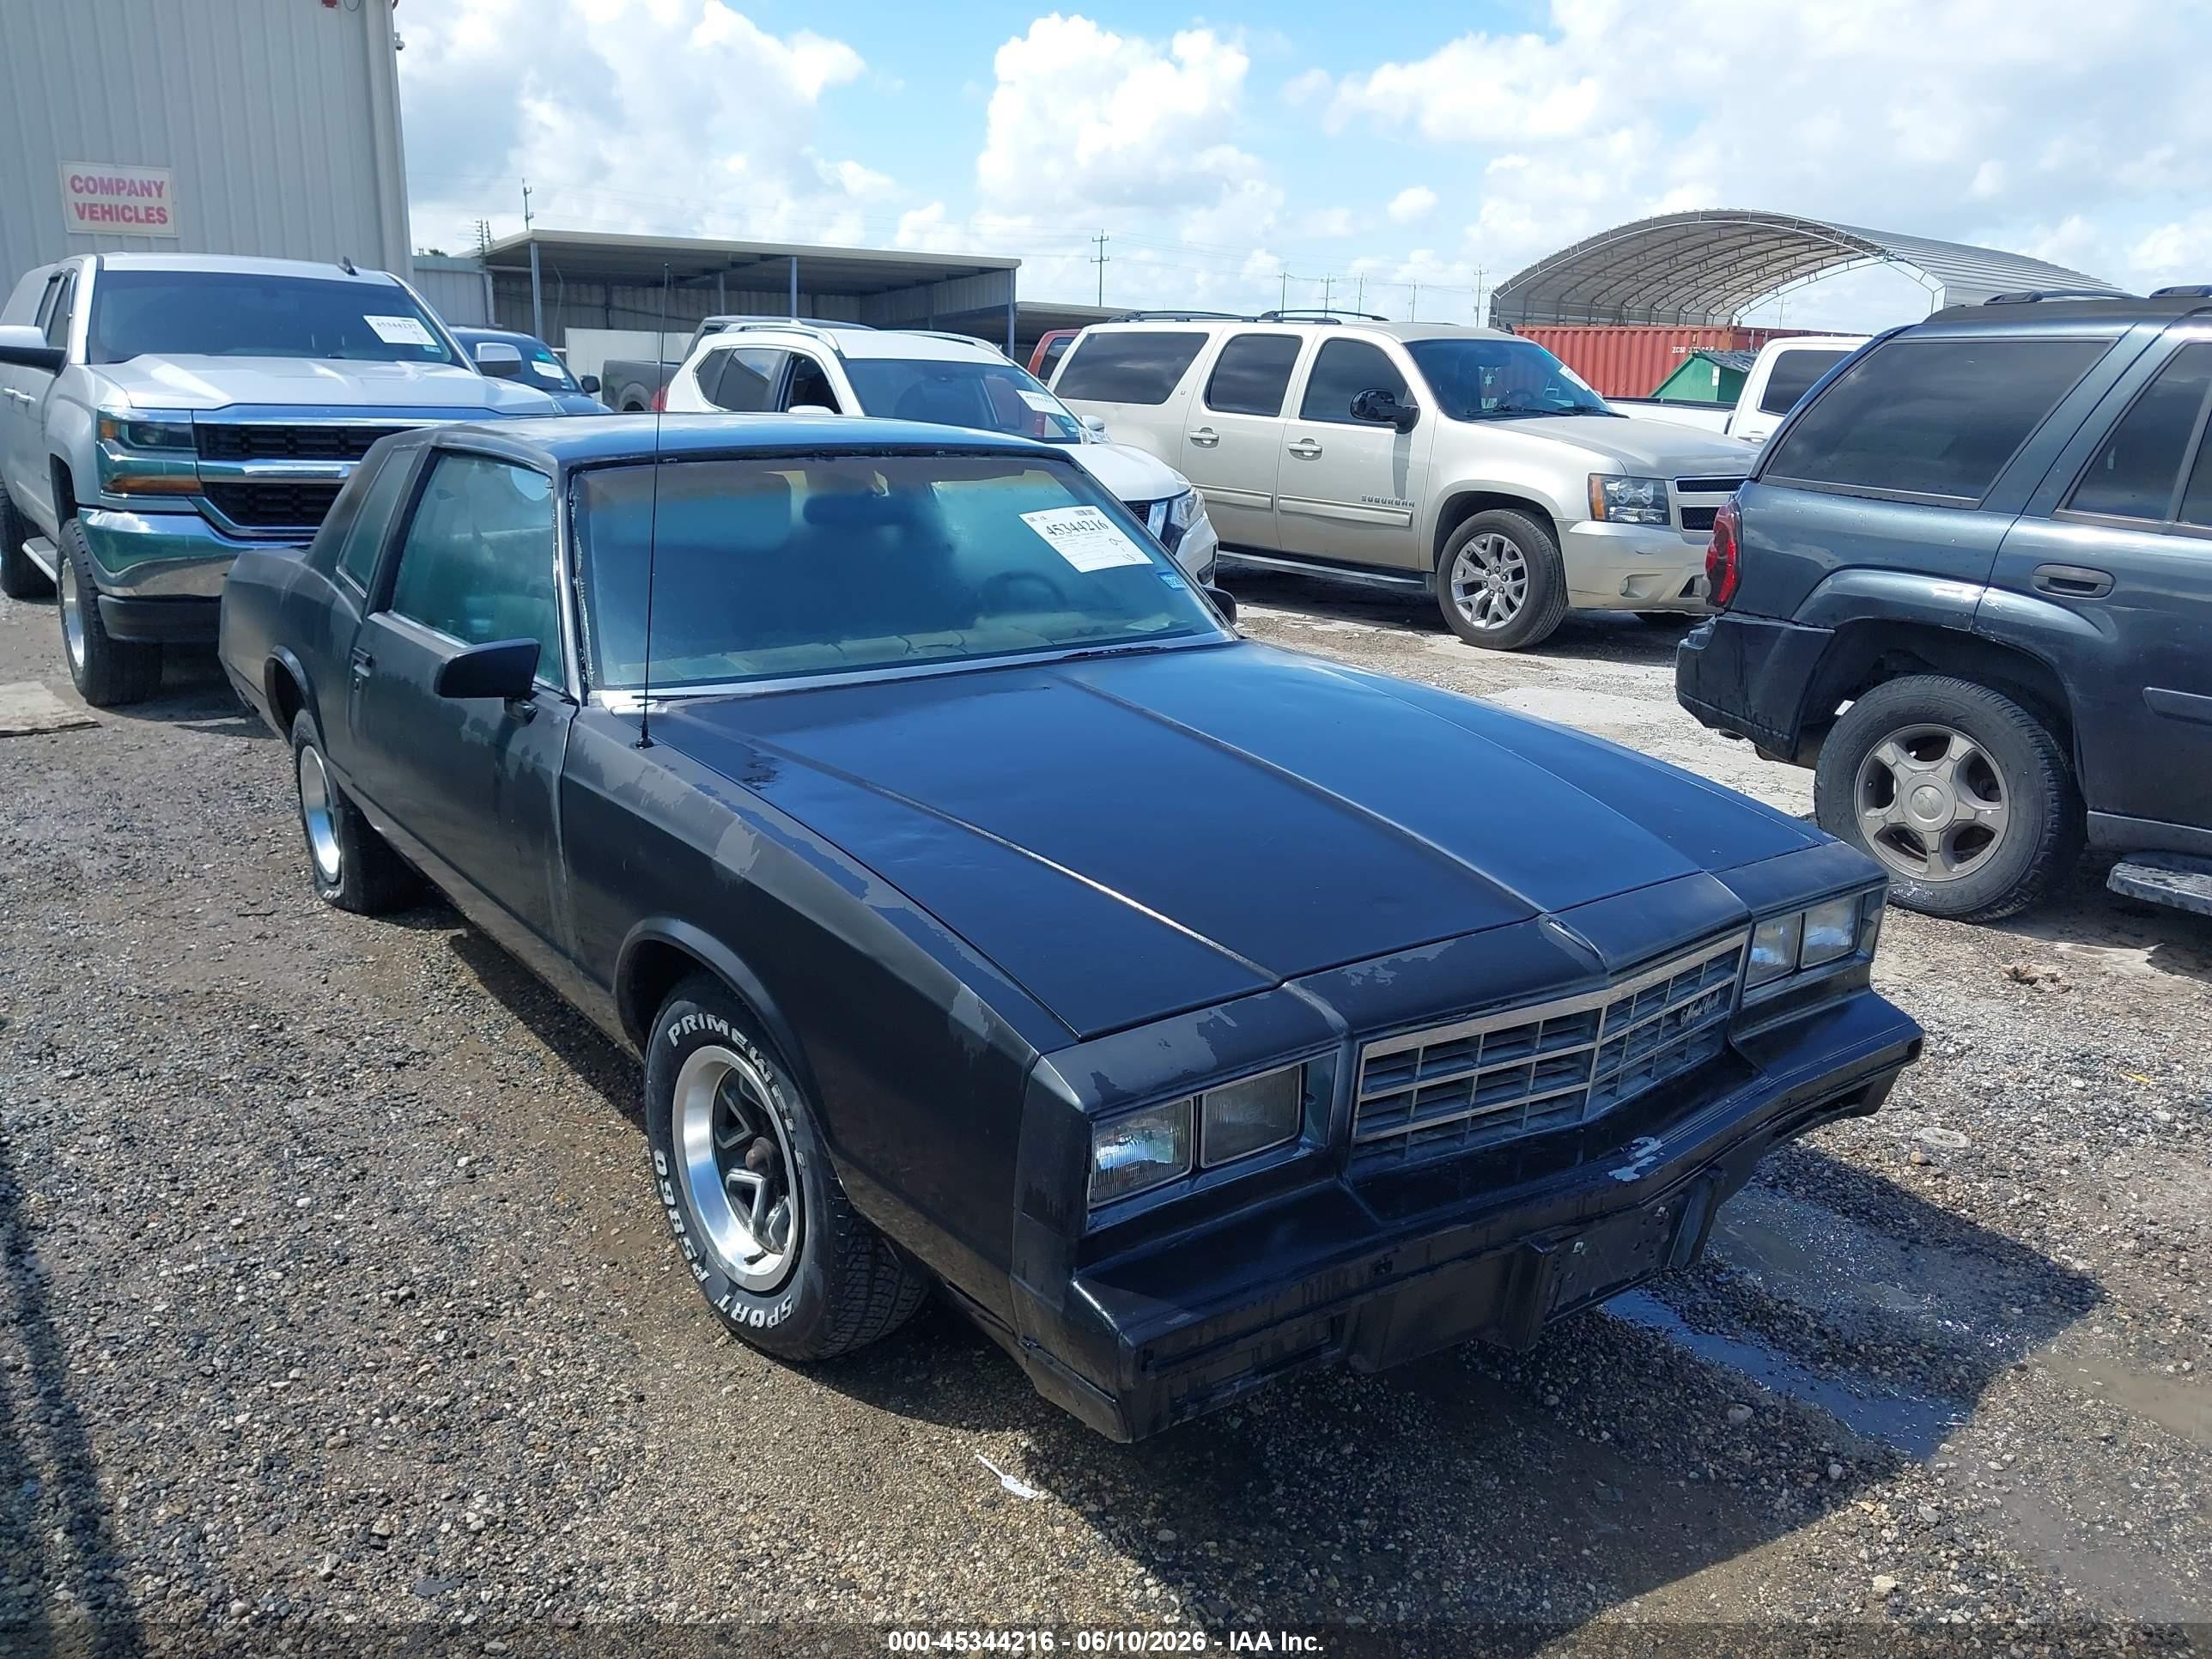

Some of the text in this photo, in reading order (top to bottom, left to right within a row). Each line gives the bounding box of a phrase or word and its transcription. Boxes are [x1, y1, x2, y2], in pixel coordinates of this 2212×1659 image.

[70, 174, 166, 198] COMPANY
[74, 202, 168, 225] VEHICLES
[1360, 495, 1416, 508] SUBURBAN
[1046, 518, 1109, 537] 45344216
[714, 1292, 794, 1330] SPORT
